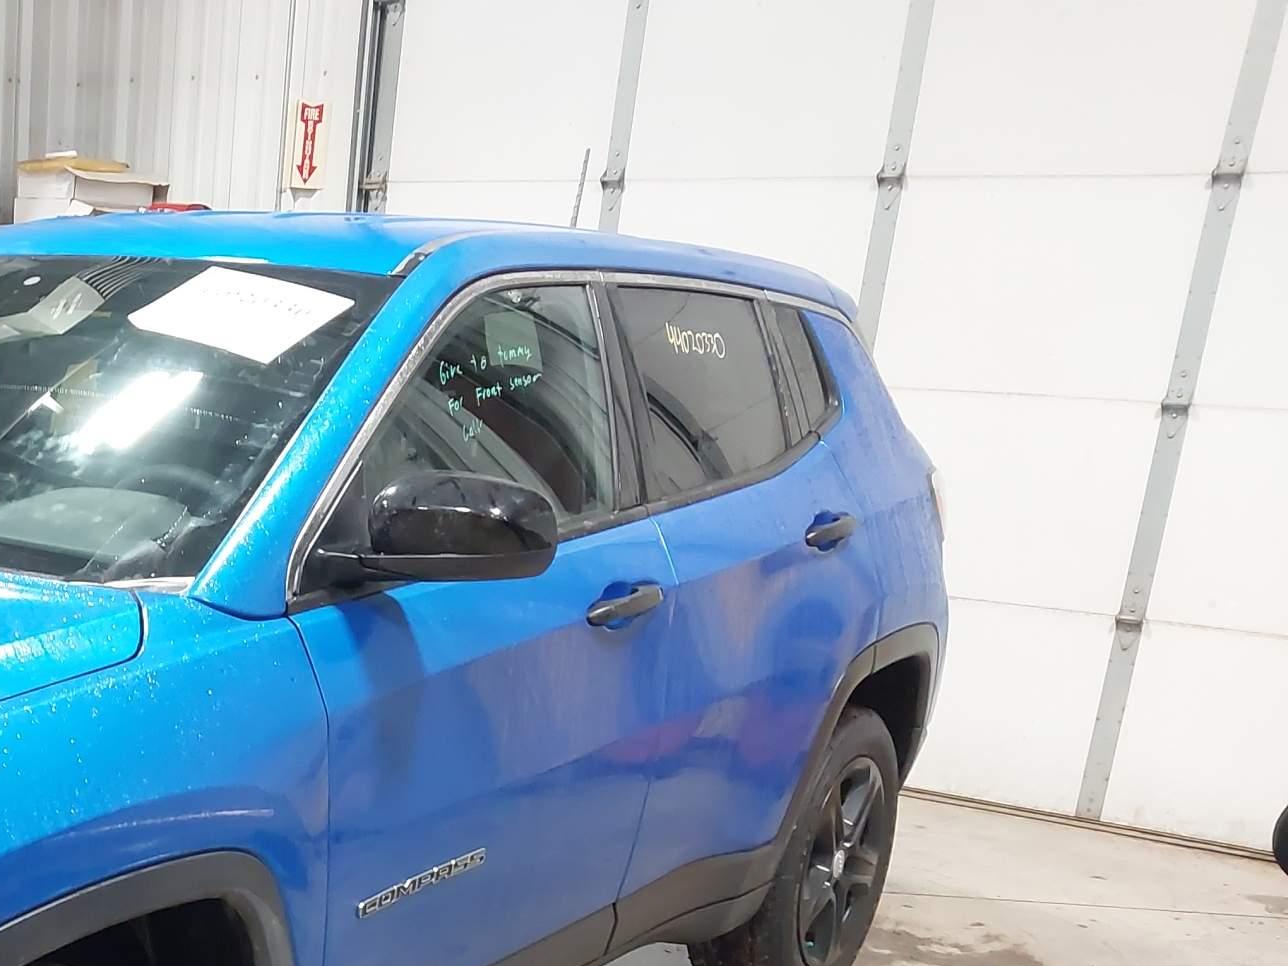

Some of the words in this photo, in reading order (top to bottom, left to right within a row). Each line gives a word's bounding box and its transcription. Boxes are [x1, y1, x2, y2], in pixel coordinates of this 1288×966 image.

[303, 107, 321, 121] FIRE
[665, 321, 726, 359] 44020330
[439, 360, 463, 385] Give
[470, 353, 487, 373] to
[448, 396, 463, 416] For
[476, 383, 503, 406] Front
[358, 847, 487, 919] COMPASS
